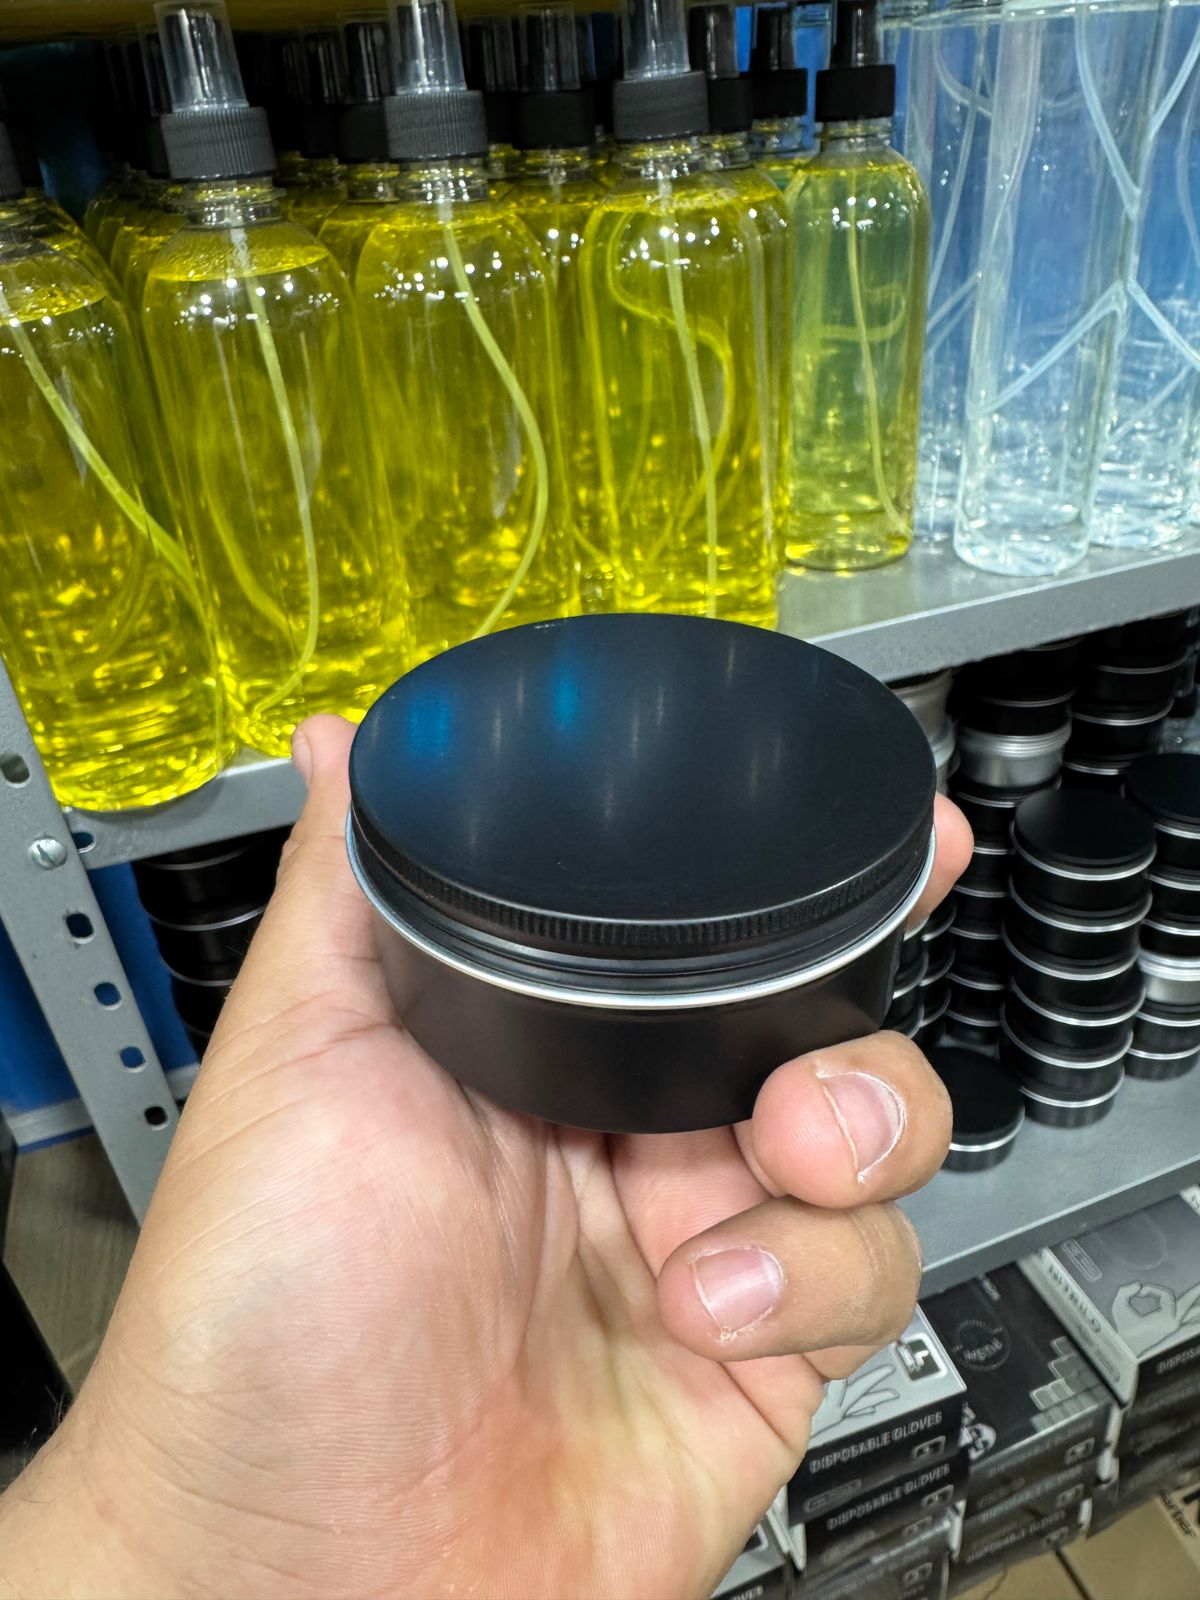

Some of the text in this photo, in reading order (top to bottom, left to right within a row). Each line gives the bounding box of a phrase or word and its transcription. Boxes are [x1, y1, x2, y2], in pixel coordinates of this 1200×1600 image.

[809, 1411, 942, 1474] DISPOSABLE GLOVES
[826, 1485, 902, 1530] DISPOSABLE
[903, 1463, 950, 1493] GLOVES
